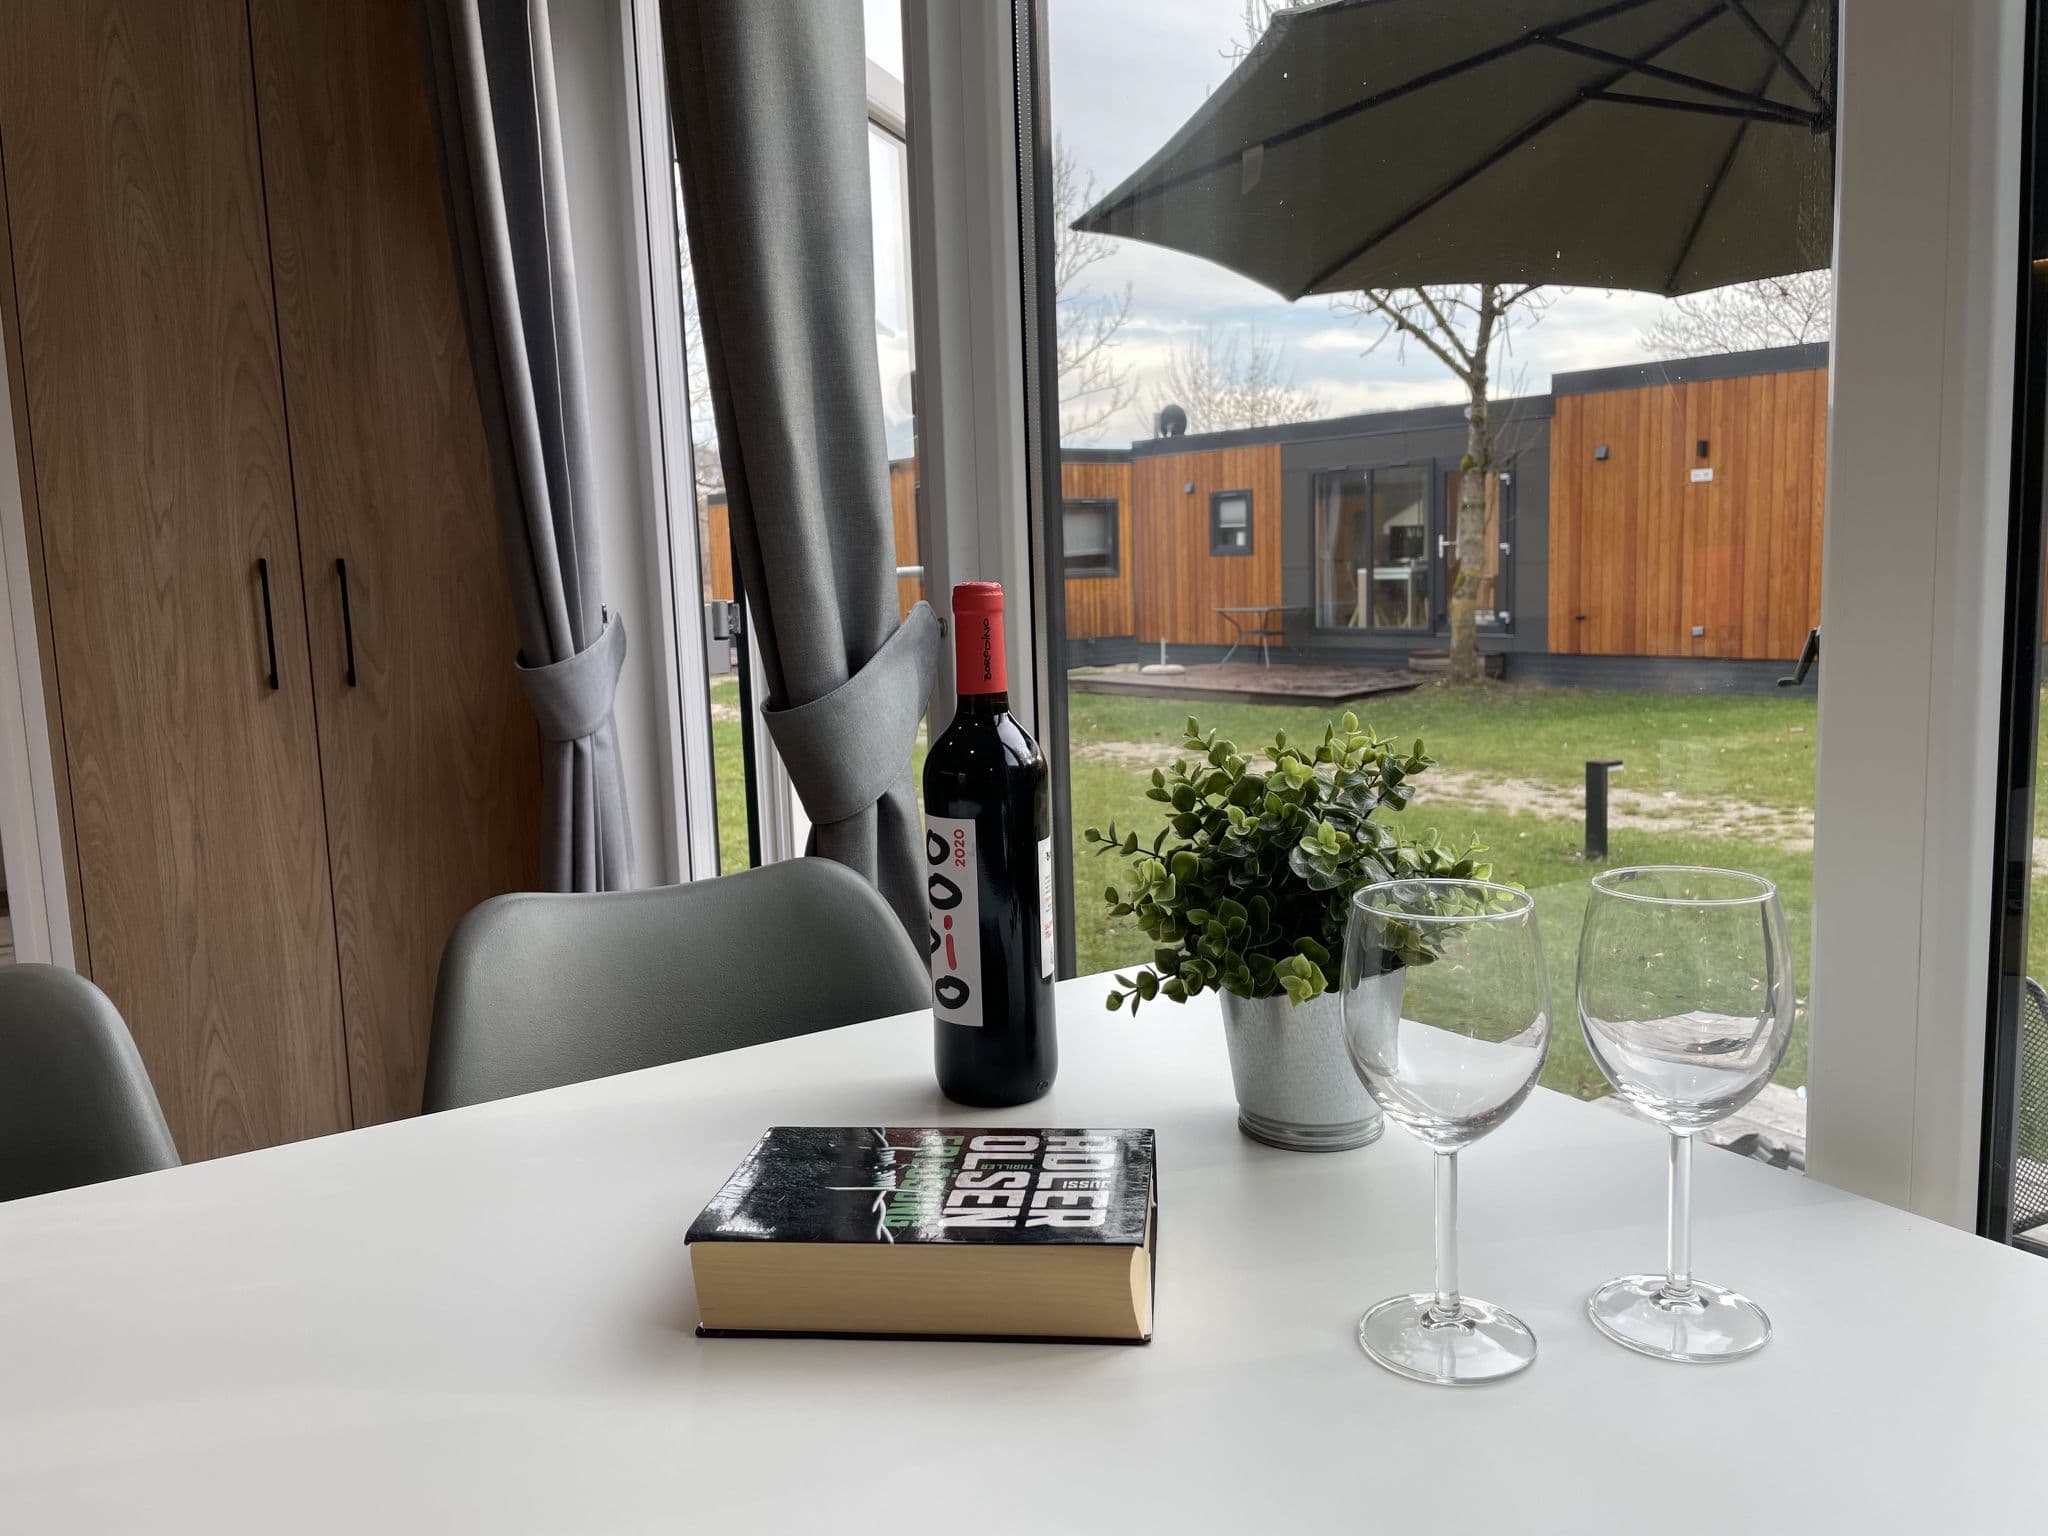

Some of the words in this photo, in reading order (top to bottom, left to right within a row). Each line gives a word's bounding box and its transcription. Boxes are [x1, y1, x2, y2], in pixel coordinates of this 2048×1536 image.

[954, 828, 966, 868] 2020
[942, 1135, 1040, 1227] OLSEN
[1024, 1135, 1118, 1227] ADLER
[1062, 1180, 1111, 1189] JUSSI
